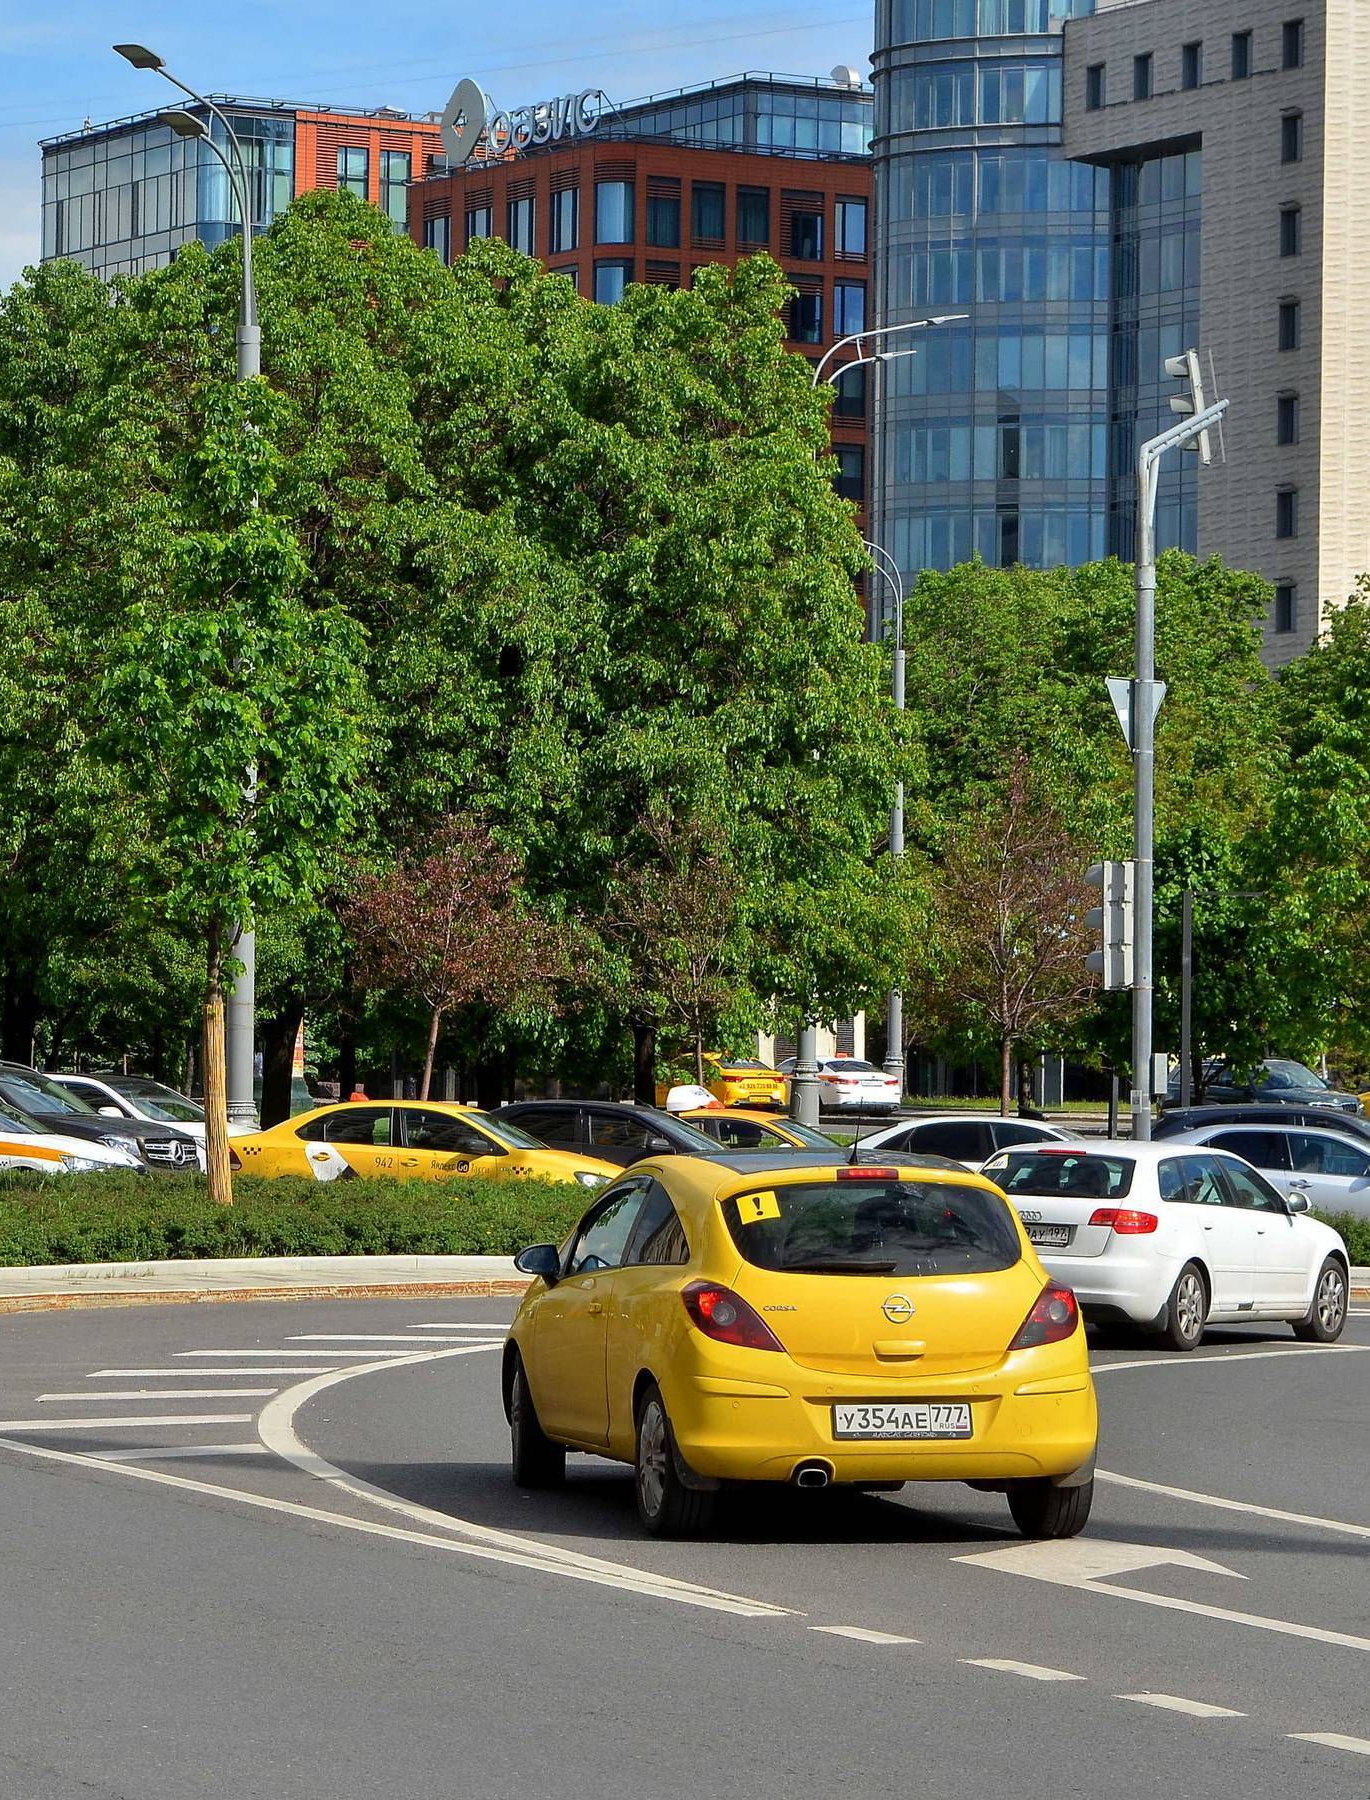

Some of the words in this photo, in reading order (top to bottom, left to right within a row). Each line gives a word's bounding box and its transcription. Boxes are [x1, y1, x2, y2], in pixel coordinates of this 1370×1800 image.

[374, 1157, 394, 1169] 942
[457, 1161, 469, 1172] Go
[843, 1407, 928, 1430] У354АЕ
[931, 1406, 964, 1423] 777
